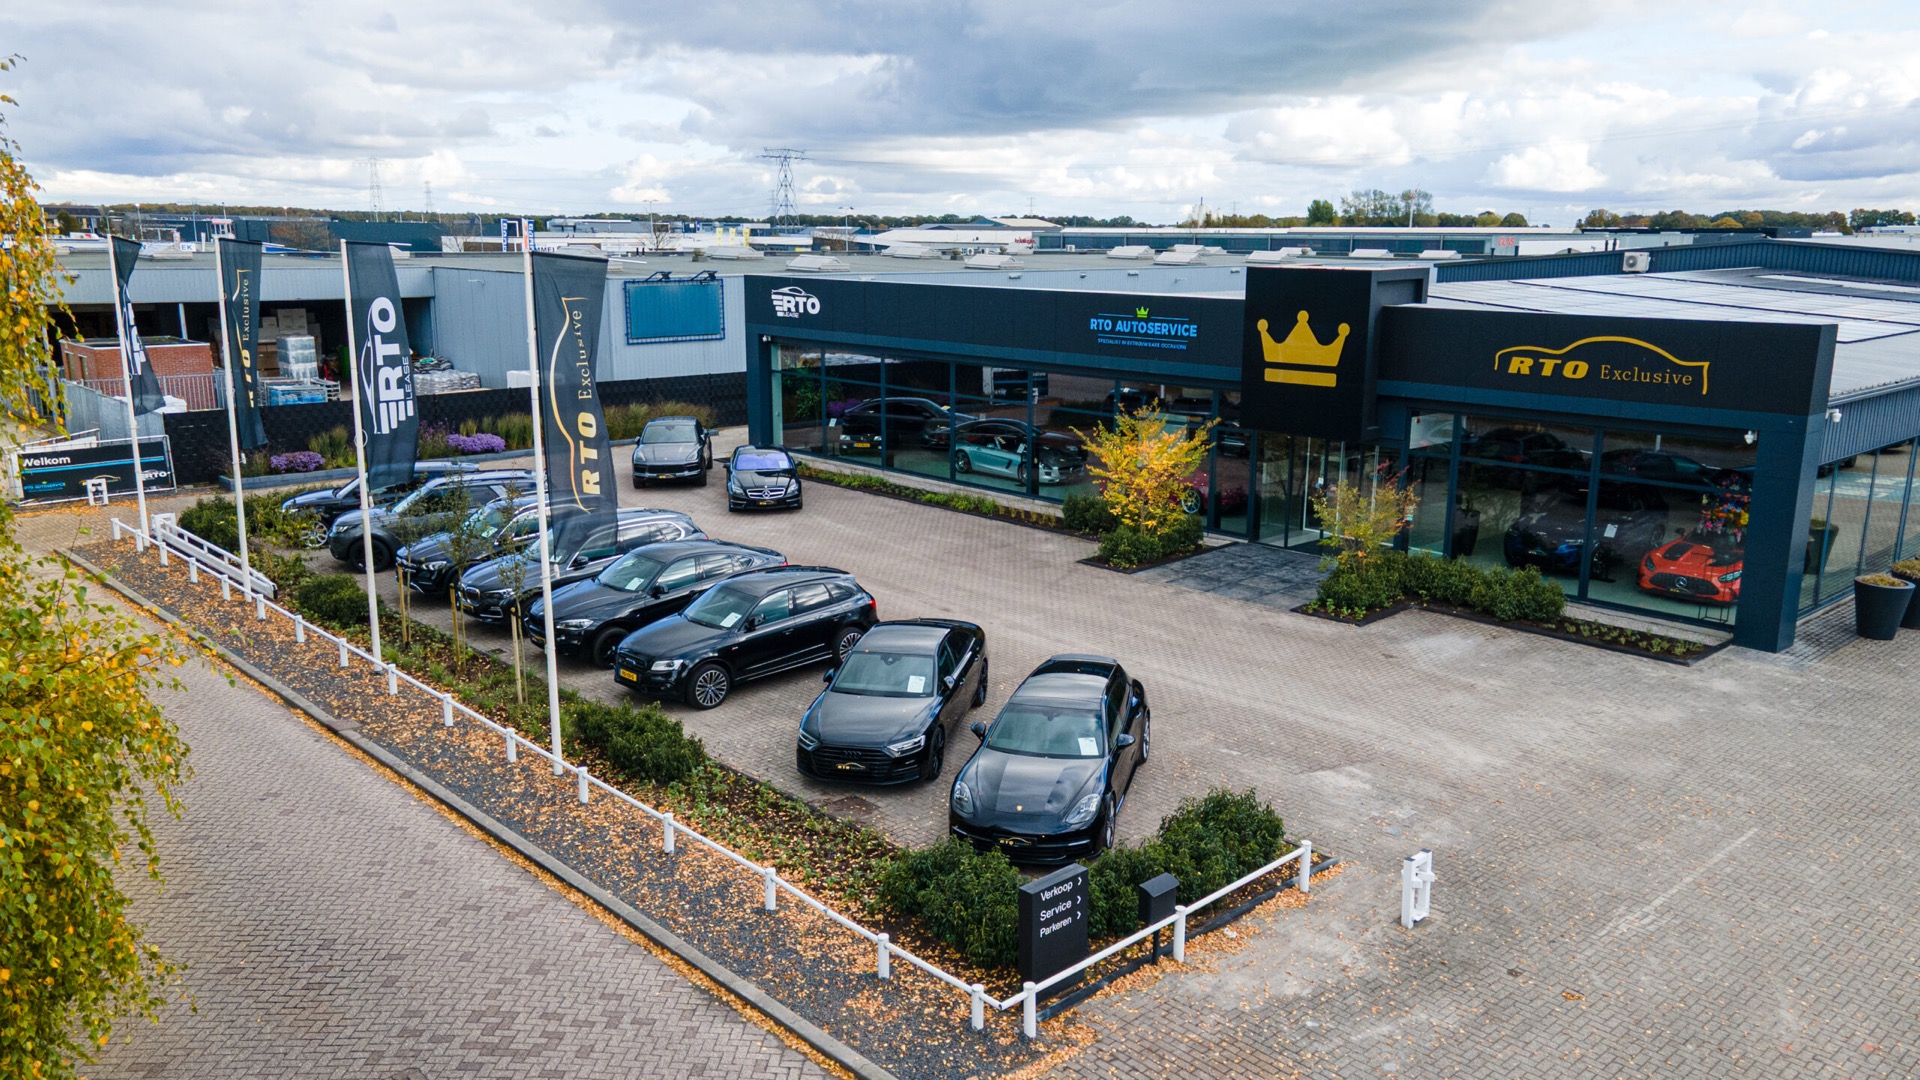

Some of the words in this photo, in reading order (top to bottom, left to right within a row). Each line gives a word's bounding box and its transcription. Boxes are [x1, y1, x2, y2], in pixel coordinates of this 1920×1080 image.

[242, 279, 250, 341] Exclusive
[782, 295, 821, 315] RTO
[1090, 318, 1112, 331] RTO
[1115, 320, 1198, 337] AUTOSERVICE
[372, 296, 405, 402] RTO
[572, 310, 592, 400] Exclusive
[402, 356, 413, 400] LEASE
[1507, 356, 1590, 380] RTO
[1600, 364, 1693, 386] Exclusive
[23, 456, 71, 468] Welkom
[577, 412, 601, 495] RTO
[1040, 881, 1073, 901] Verkoop
[1040, 900, 1072, 921] Service
[1040, 917, 1072, 938] Parkeren
